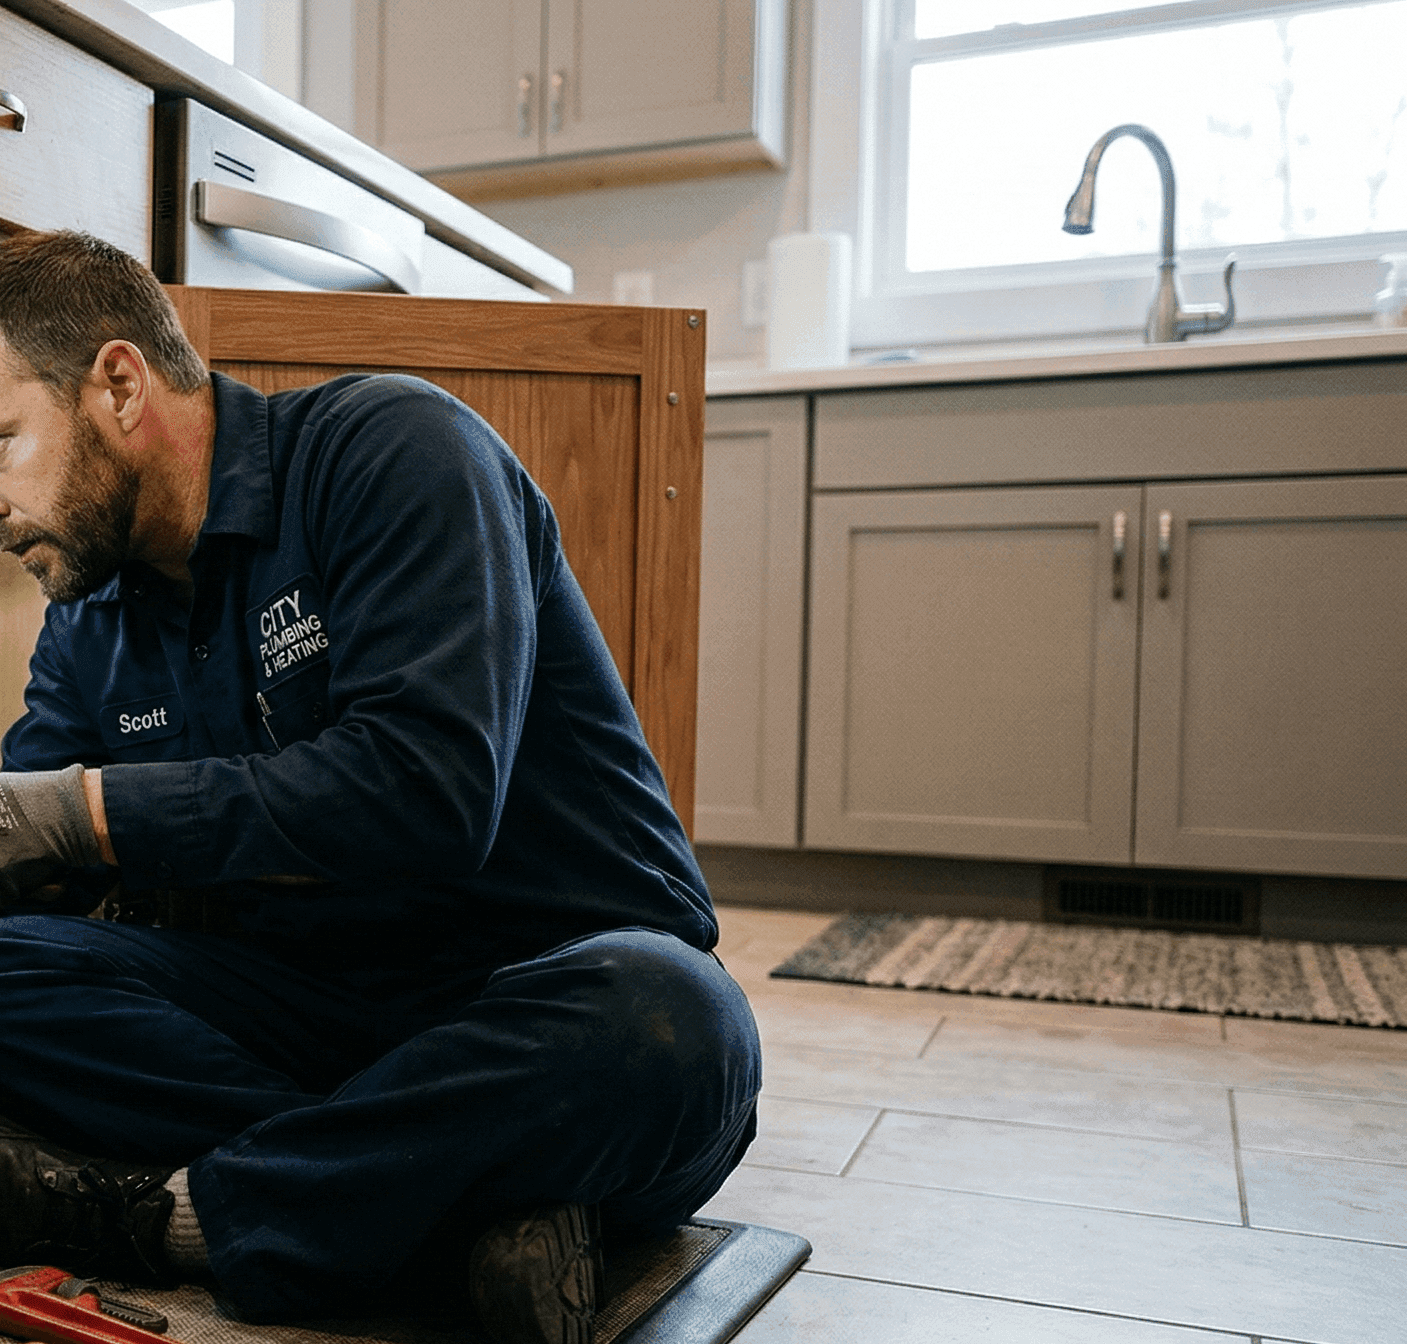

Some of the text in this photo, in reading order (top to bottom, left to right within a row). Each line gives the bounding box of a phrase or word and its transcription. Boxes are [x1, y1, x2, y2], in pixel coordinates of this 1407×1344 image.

[260, 589, 301, 638] CITY
[259, 614, 322, 661] PLUMBING
[264, 632, 329, 678] & HEATING
[119, 707, 168, 734] Scott
